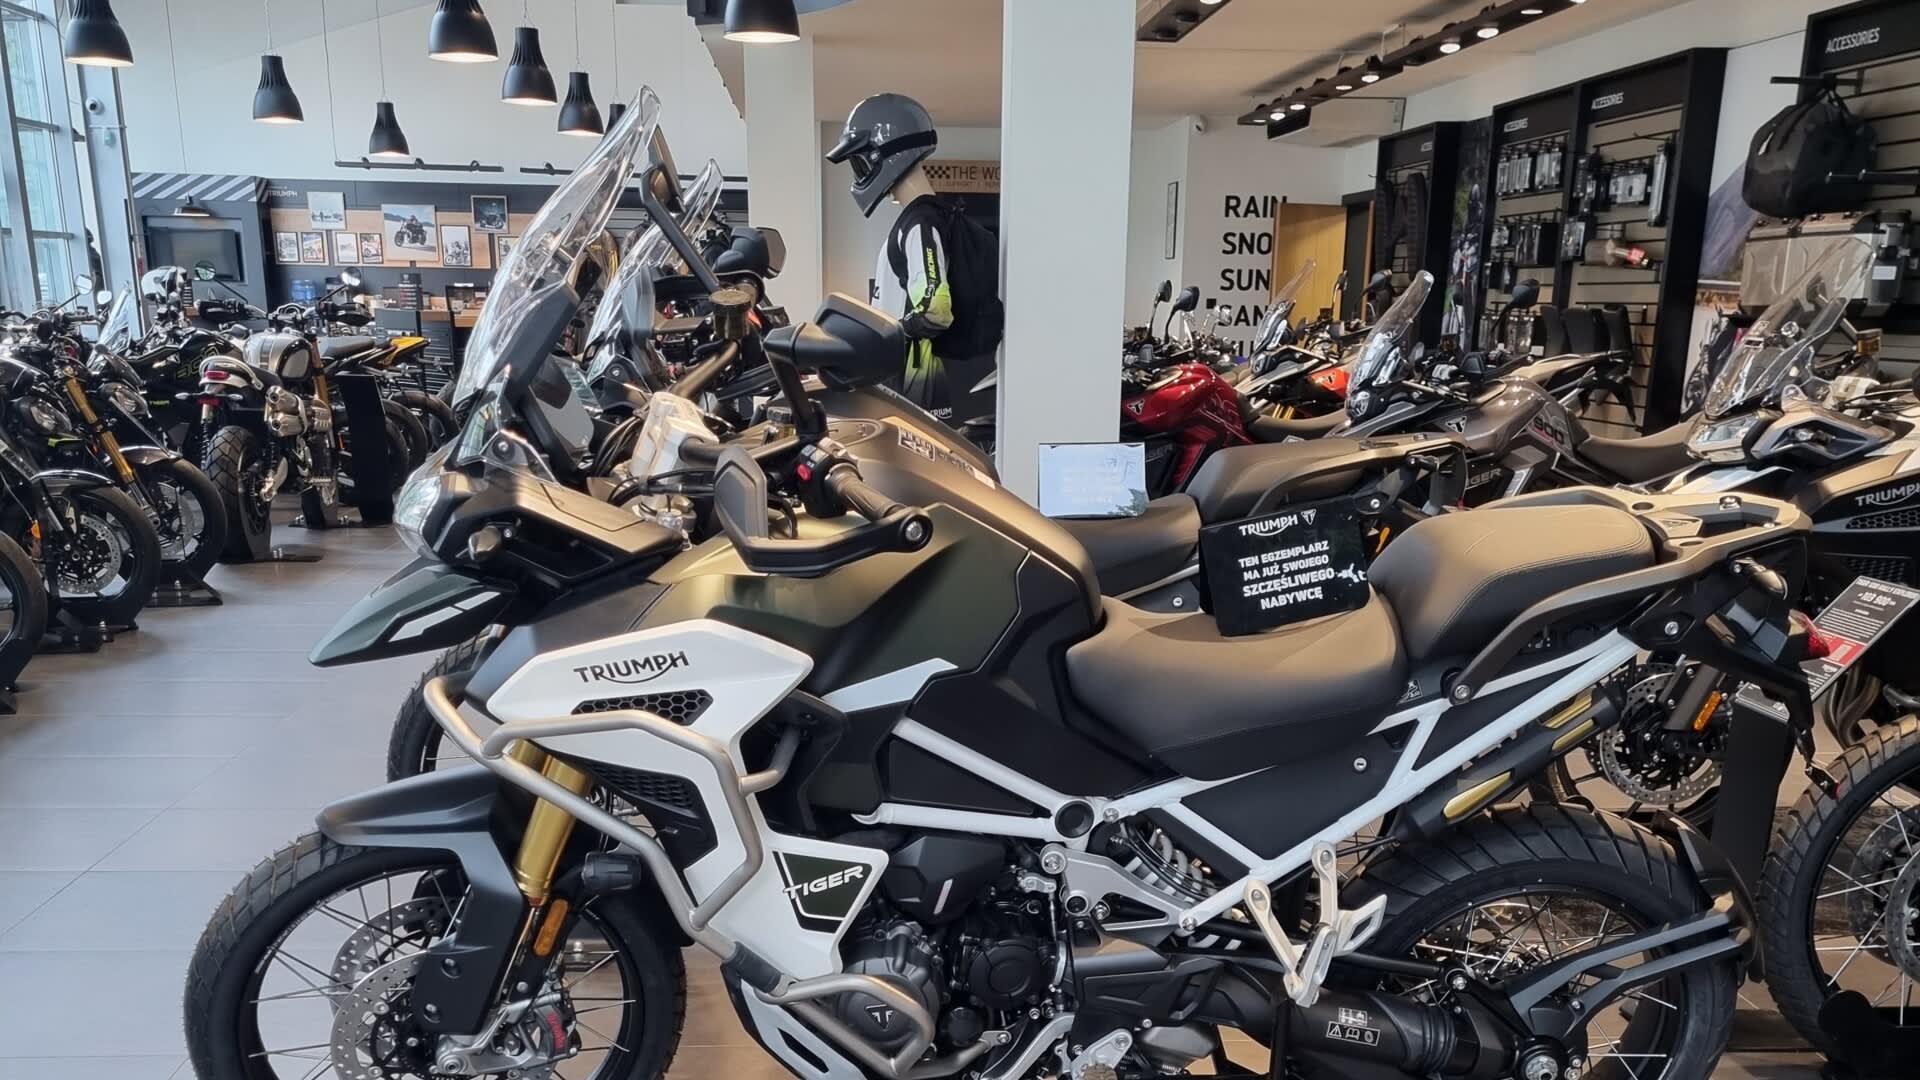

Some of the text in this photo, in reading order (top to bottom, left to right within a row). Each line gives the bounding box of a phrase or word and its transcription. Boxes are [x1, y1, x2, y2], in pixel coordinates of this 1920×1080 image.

[1825, 27, 1880, 54] ACCESSORIES
[952, 166, 977, 180] THE
[1220, 268, 1270, 291] SUN
[1239, 514, 1298, 537] TRIUMPH
[1238, 540, 1330, 568] TEN EGZEMPLARZ
[1243, 554, 1330, 582] MA JUŻ SWOJEGO
[1242, 567, 1335, 597] SZCZĘŚLIWEGO
[1260, 586, 1323, 610] NABYWCĘ
[573, 651, 689, 684] TRIUMPH
[783, 865, 864, 899] TIGER
